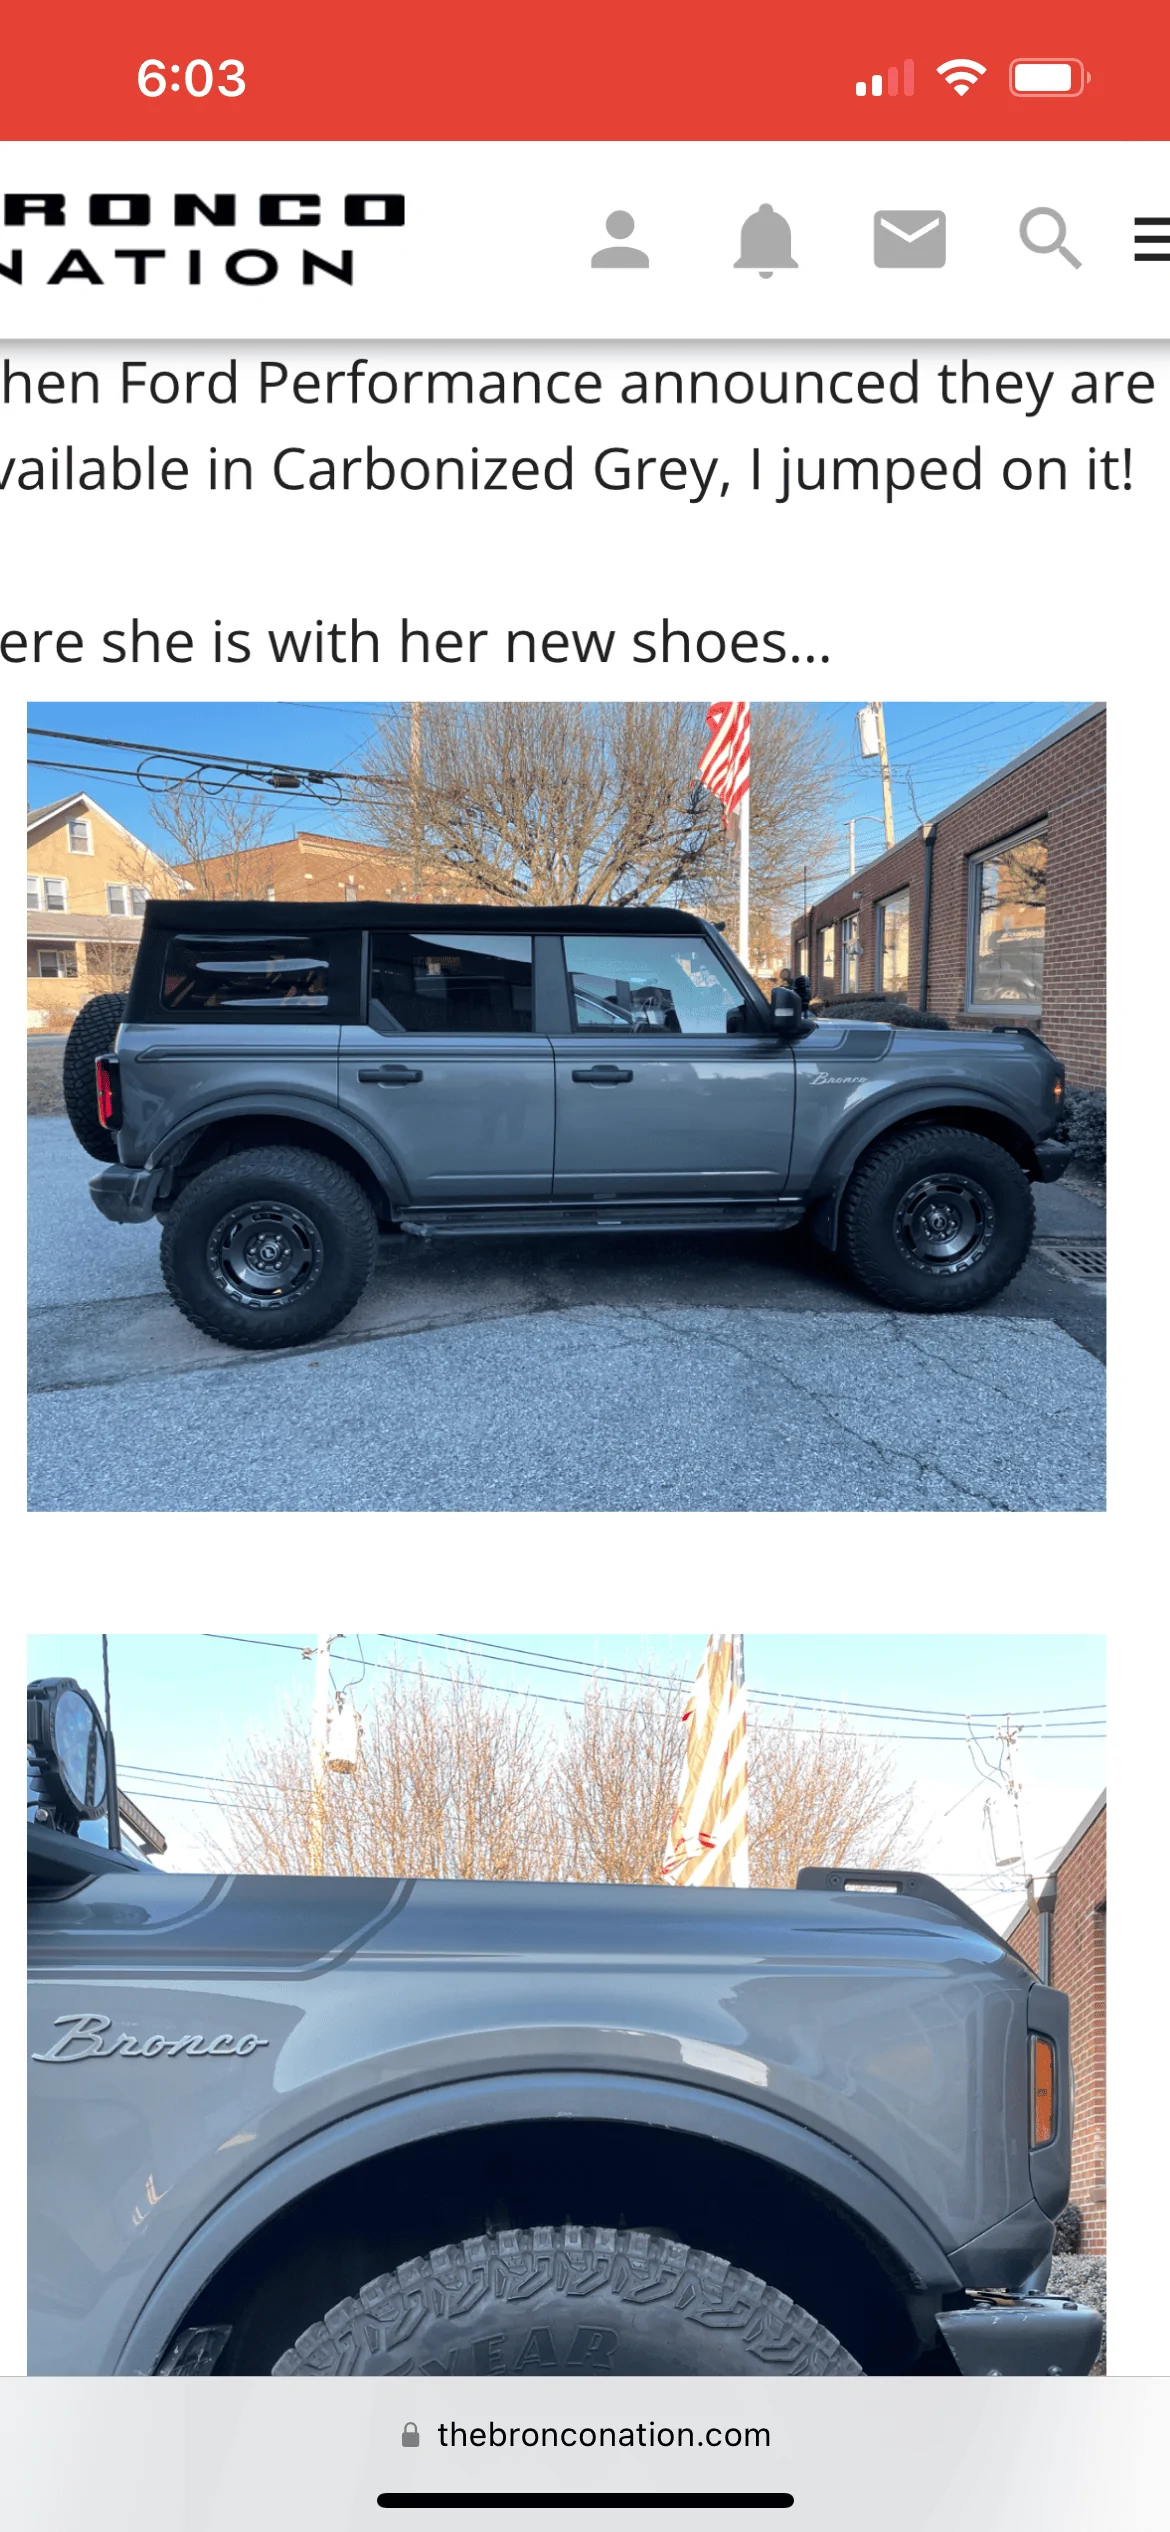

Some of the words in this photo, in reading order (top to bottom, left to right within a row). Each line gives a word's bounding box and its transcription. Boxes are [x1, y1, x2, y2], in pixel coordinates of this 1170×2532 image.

[137, 58, 246, 98] 6:03
[4, 194, 405, 226] RONCO
[4, 359, 98, 404] hen
[123, 359, 236, 404] Ford
[260, 359, 601, 404] Performance
[621, 359, 918, 404] announced
[938, 359, 1054, 417] they
[1072, 371, 1155, 404] are
[210, 447, 252, 490] in
[273, 445, 573, 490] Carbonized
[595, 448, 730, 503] Grey,
[754, 448, 759, 489] I
[776, 446, 981, 503] jumped
[1003, 457, 1066, 490] on
[1089, 447, 1131, 490] it!
[0, 631, 84, 664] ere
[103, 618, 193, 664] she
[214, 619, 250, 664] is
[268, 618, 378, 664] with
[403, 618, 489, 664] her
[509, 631, 616, 664] new
[634, 618, 829, 664] shoes...
[808, 1072, 868, 1085] Bronco
[31, 2013, 270, 2064] Bronco
[437, 2420, 770, 2447] thebronconation.com
